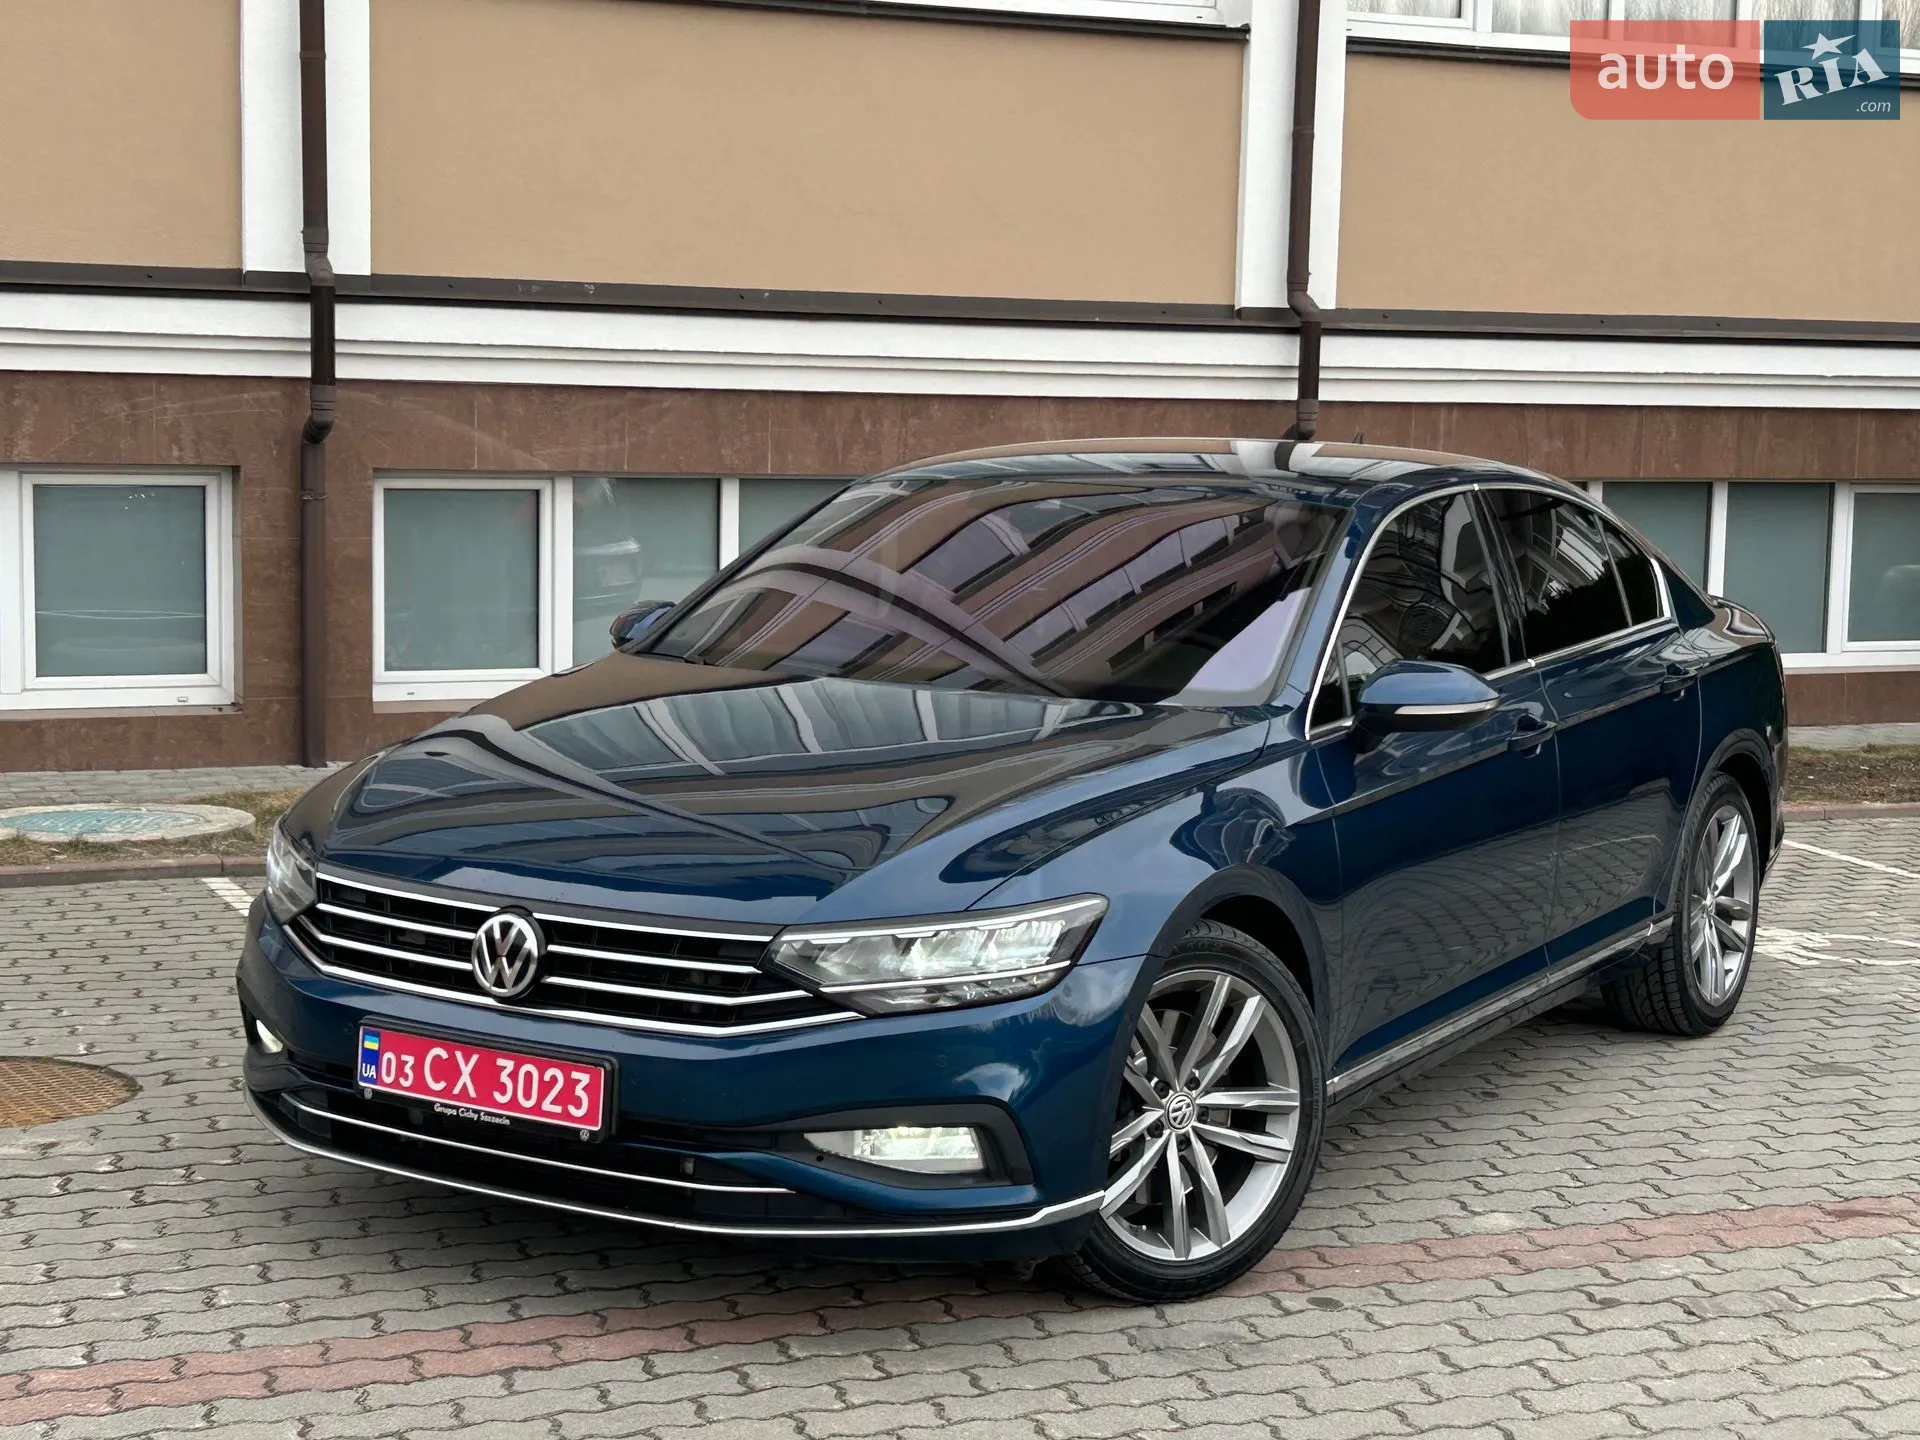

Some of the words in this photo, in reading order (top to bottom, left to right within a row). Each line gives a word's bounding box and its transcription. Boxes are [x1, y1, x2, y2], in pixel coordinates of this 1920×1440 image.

[474, 915, 535, 994] VW
[362, 1062, 377, 1080] UA
[380, 1052, 415, 1088] 03
[424, 1047, 480, 1098] CX
[492, 1057, 591, 1117] 3023
[434, 1103, 457, 1116] Grupa
